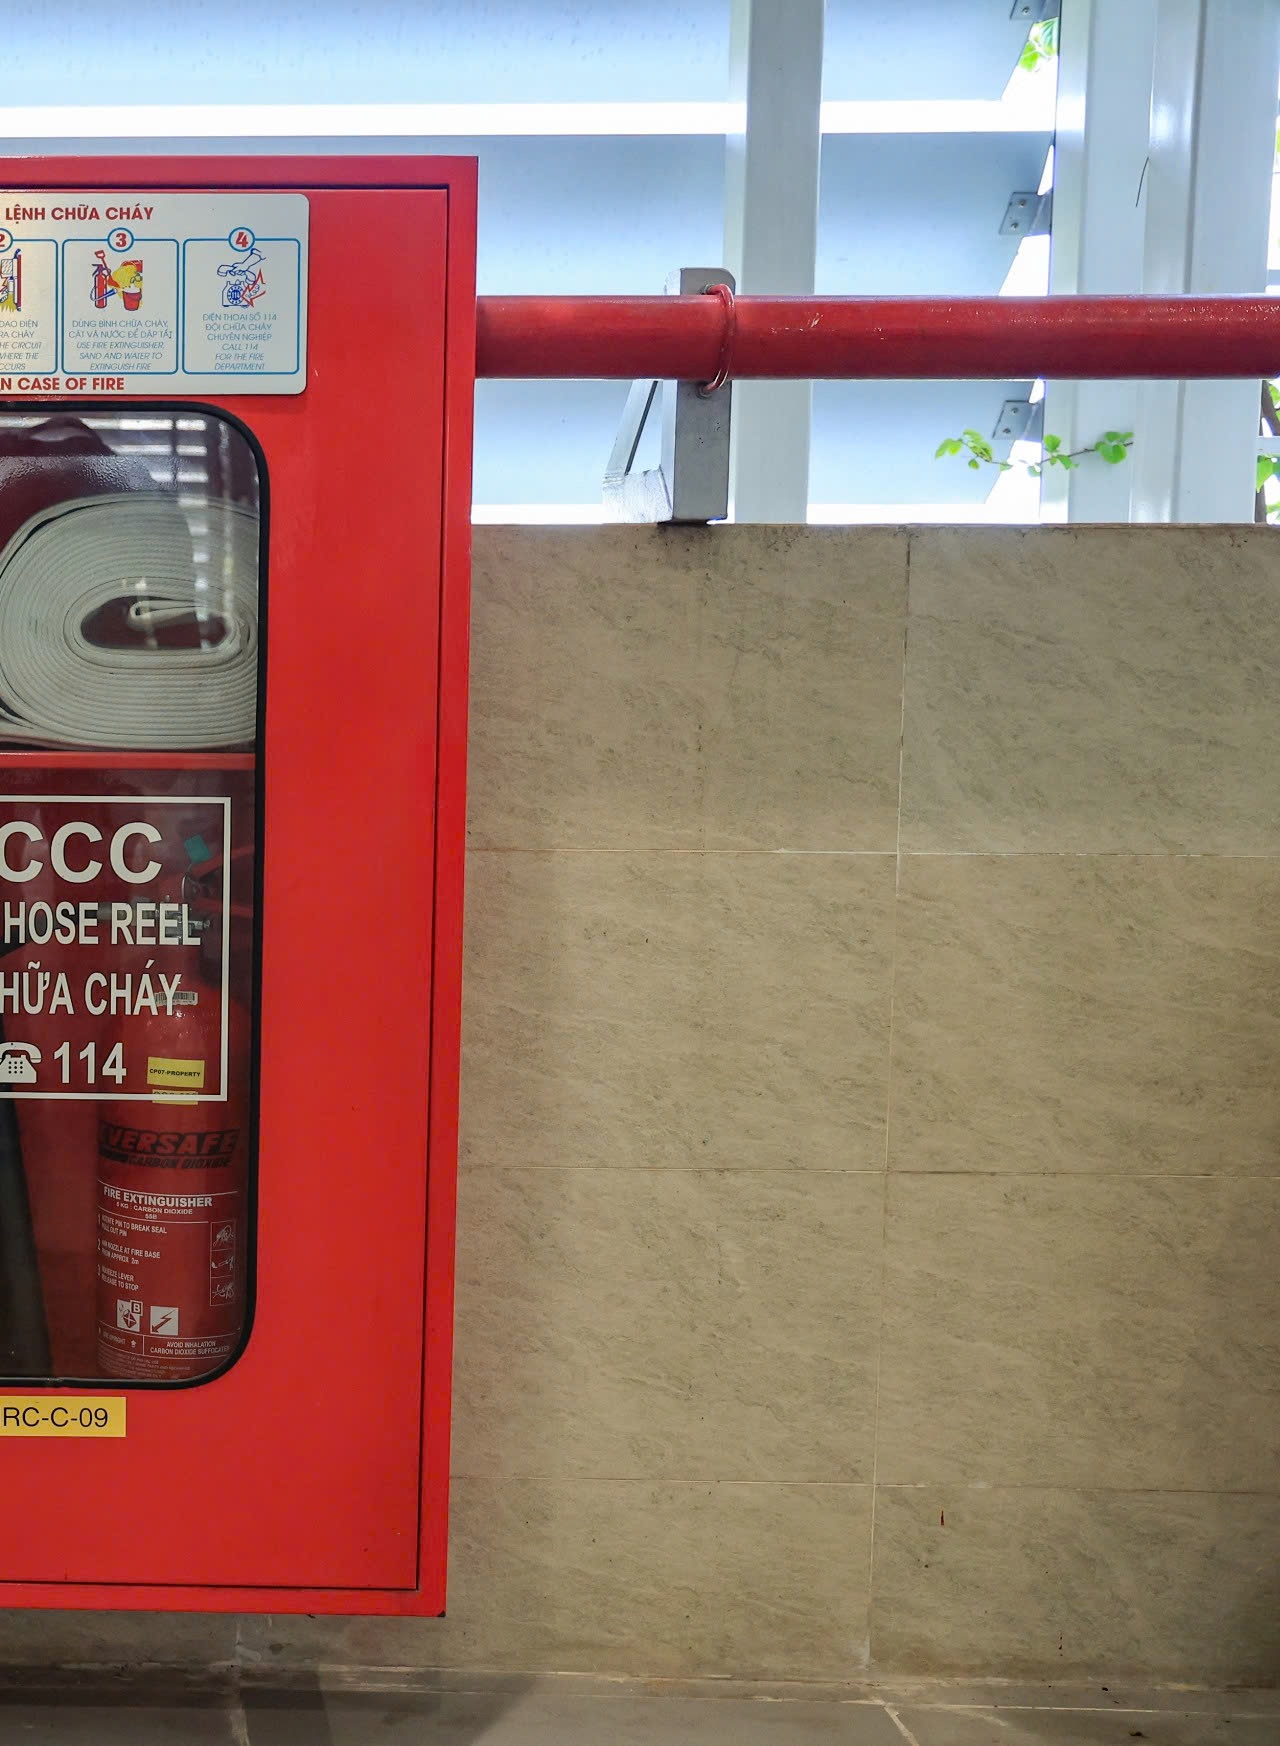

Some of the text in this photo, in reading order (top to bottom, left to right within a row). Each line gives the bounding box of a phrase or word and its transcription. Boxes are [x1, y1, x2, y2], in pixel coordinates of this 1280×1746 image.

[6, 204, 45, 225] LỆNH
[52, 204, 100, 221] CHỮA
[106, 204, 153, 221] CHÁY
[115, 234, 127, 248] 3
[235, 232, 249, 248] 4
[222, 343, 259, 351] CALL 114
[79, 352, 163, 360] SAND AND WATER TO
[215, 353, 265, 361] FOR THE FIRE
[16, 377, 61, 391] CASE
[65, 377, 88, 391] OF
[92, 377, 125, 391] FIRE
[4, 901, 99, 944] HOSE
[111, 902, 201, 945] REEL
[85, 959, 182, 1016] CHÁY
[53, 1041, 127, 1085] 114
[149, 1068, 201, 1077] CP07-PROPERTY
[104, 1186, 213, 1208] FIRE EXTINGUISHER
[133, 1205, 162, 1213] CARBON
[131, 1223, 150, 1233] BREAK
[151, 1225, 167, 1234] SEAL
[131, 1247, 143, 1257] FIRE
[144, 1251, 160, 1259] BASE
[118, 1272, 134, 1281] LEVER
[118, 1281, 139, 1291] TO STOP
[133, 1304, 140, 1312] B
[184, 1340, 216, 1348] INHALATION
[151, 1347, 174, 1355] CARBON
